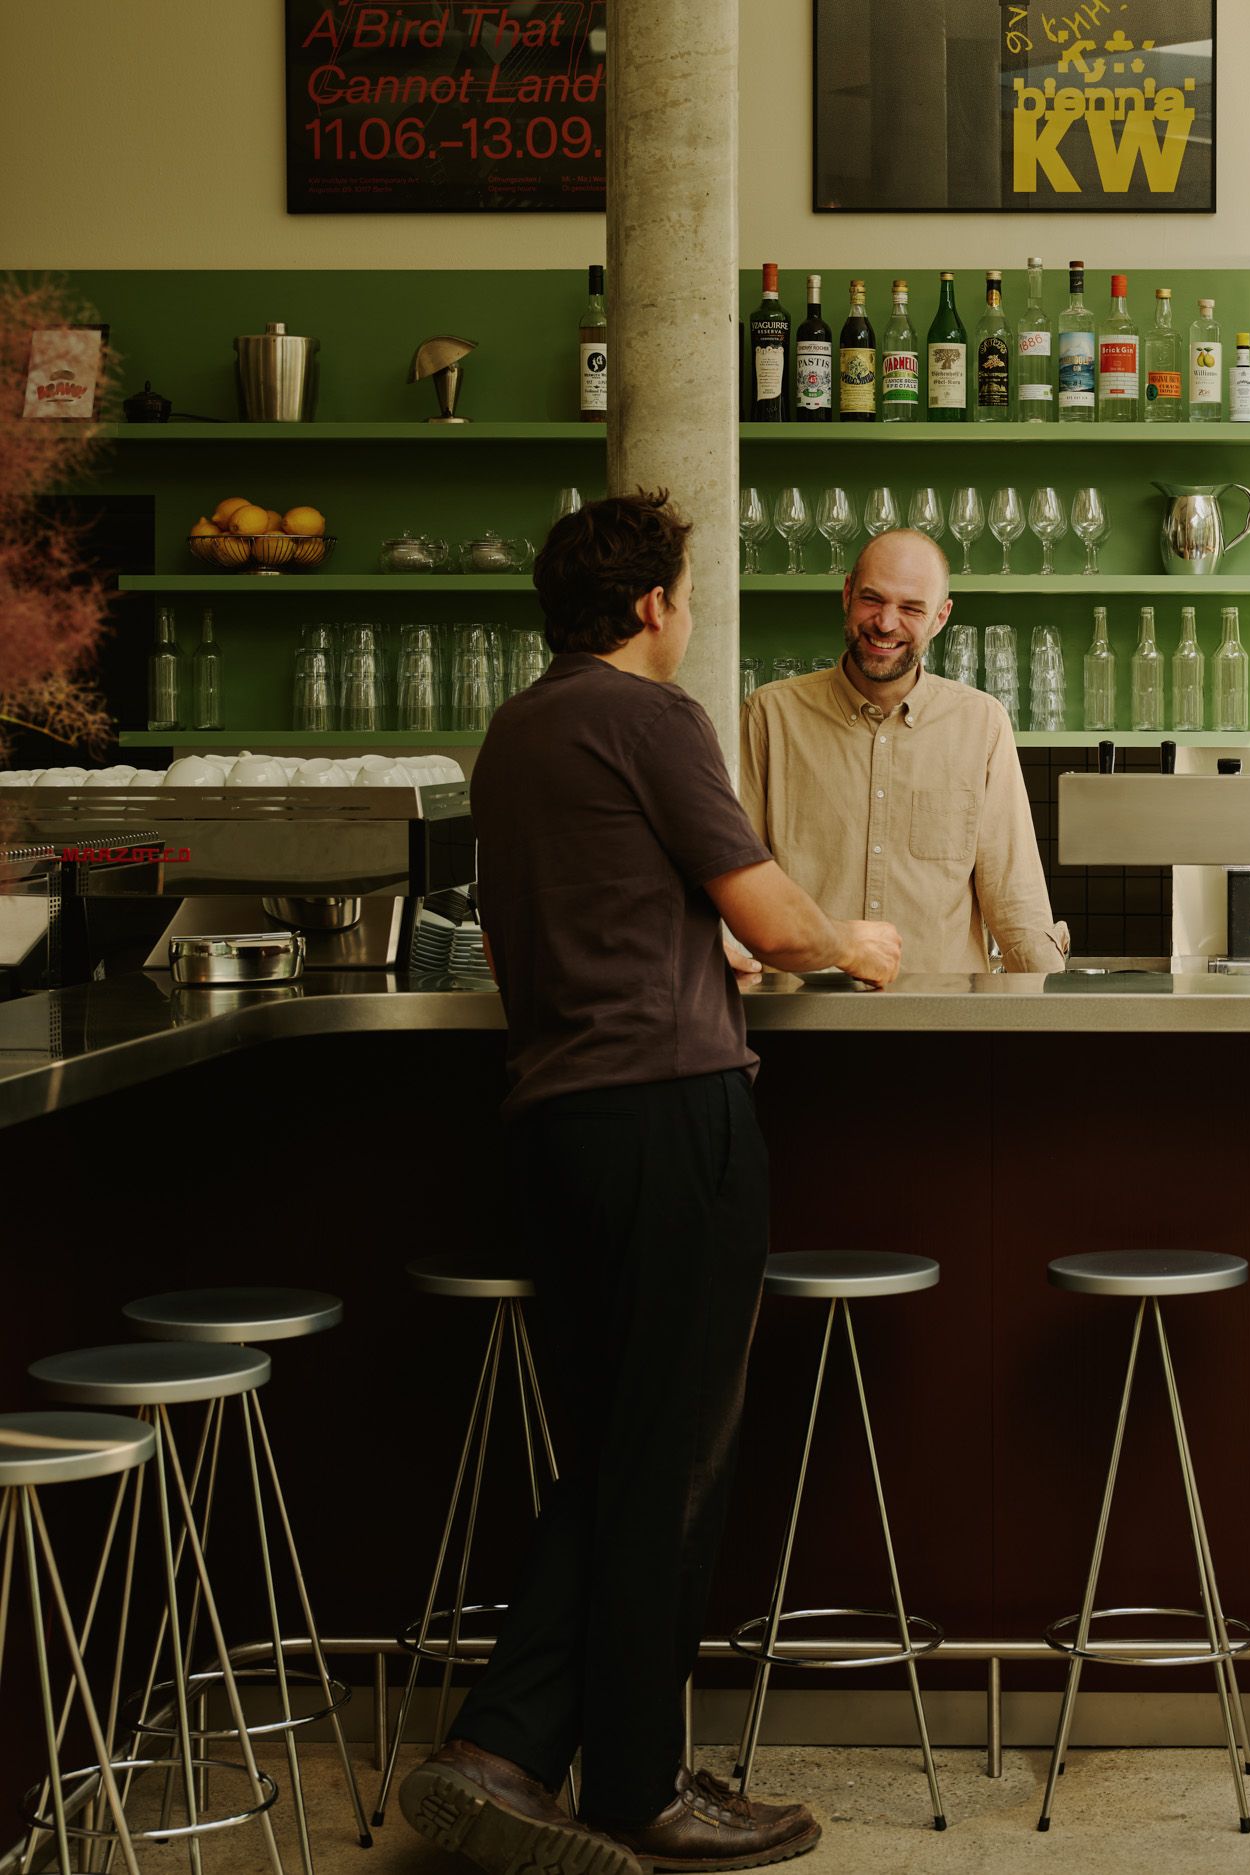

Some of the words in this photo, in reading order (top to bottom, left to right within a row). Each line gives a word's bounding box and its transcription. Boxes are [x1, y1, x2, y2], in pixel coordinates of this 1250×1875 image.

[301, 9, 339, 48] A
[353, 8, 449, 48] Bird
[462, 8, 566, 48] That
[307, 64, 475, 104] Cannot
[486, 63, 604, 104] Land
[1014, 110, 1194, 193] KW
[798, 357, 830, 369] PASTIS
[1019, 334, 1043, 353] 1886
